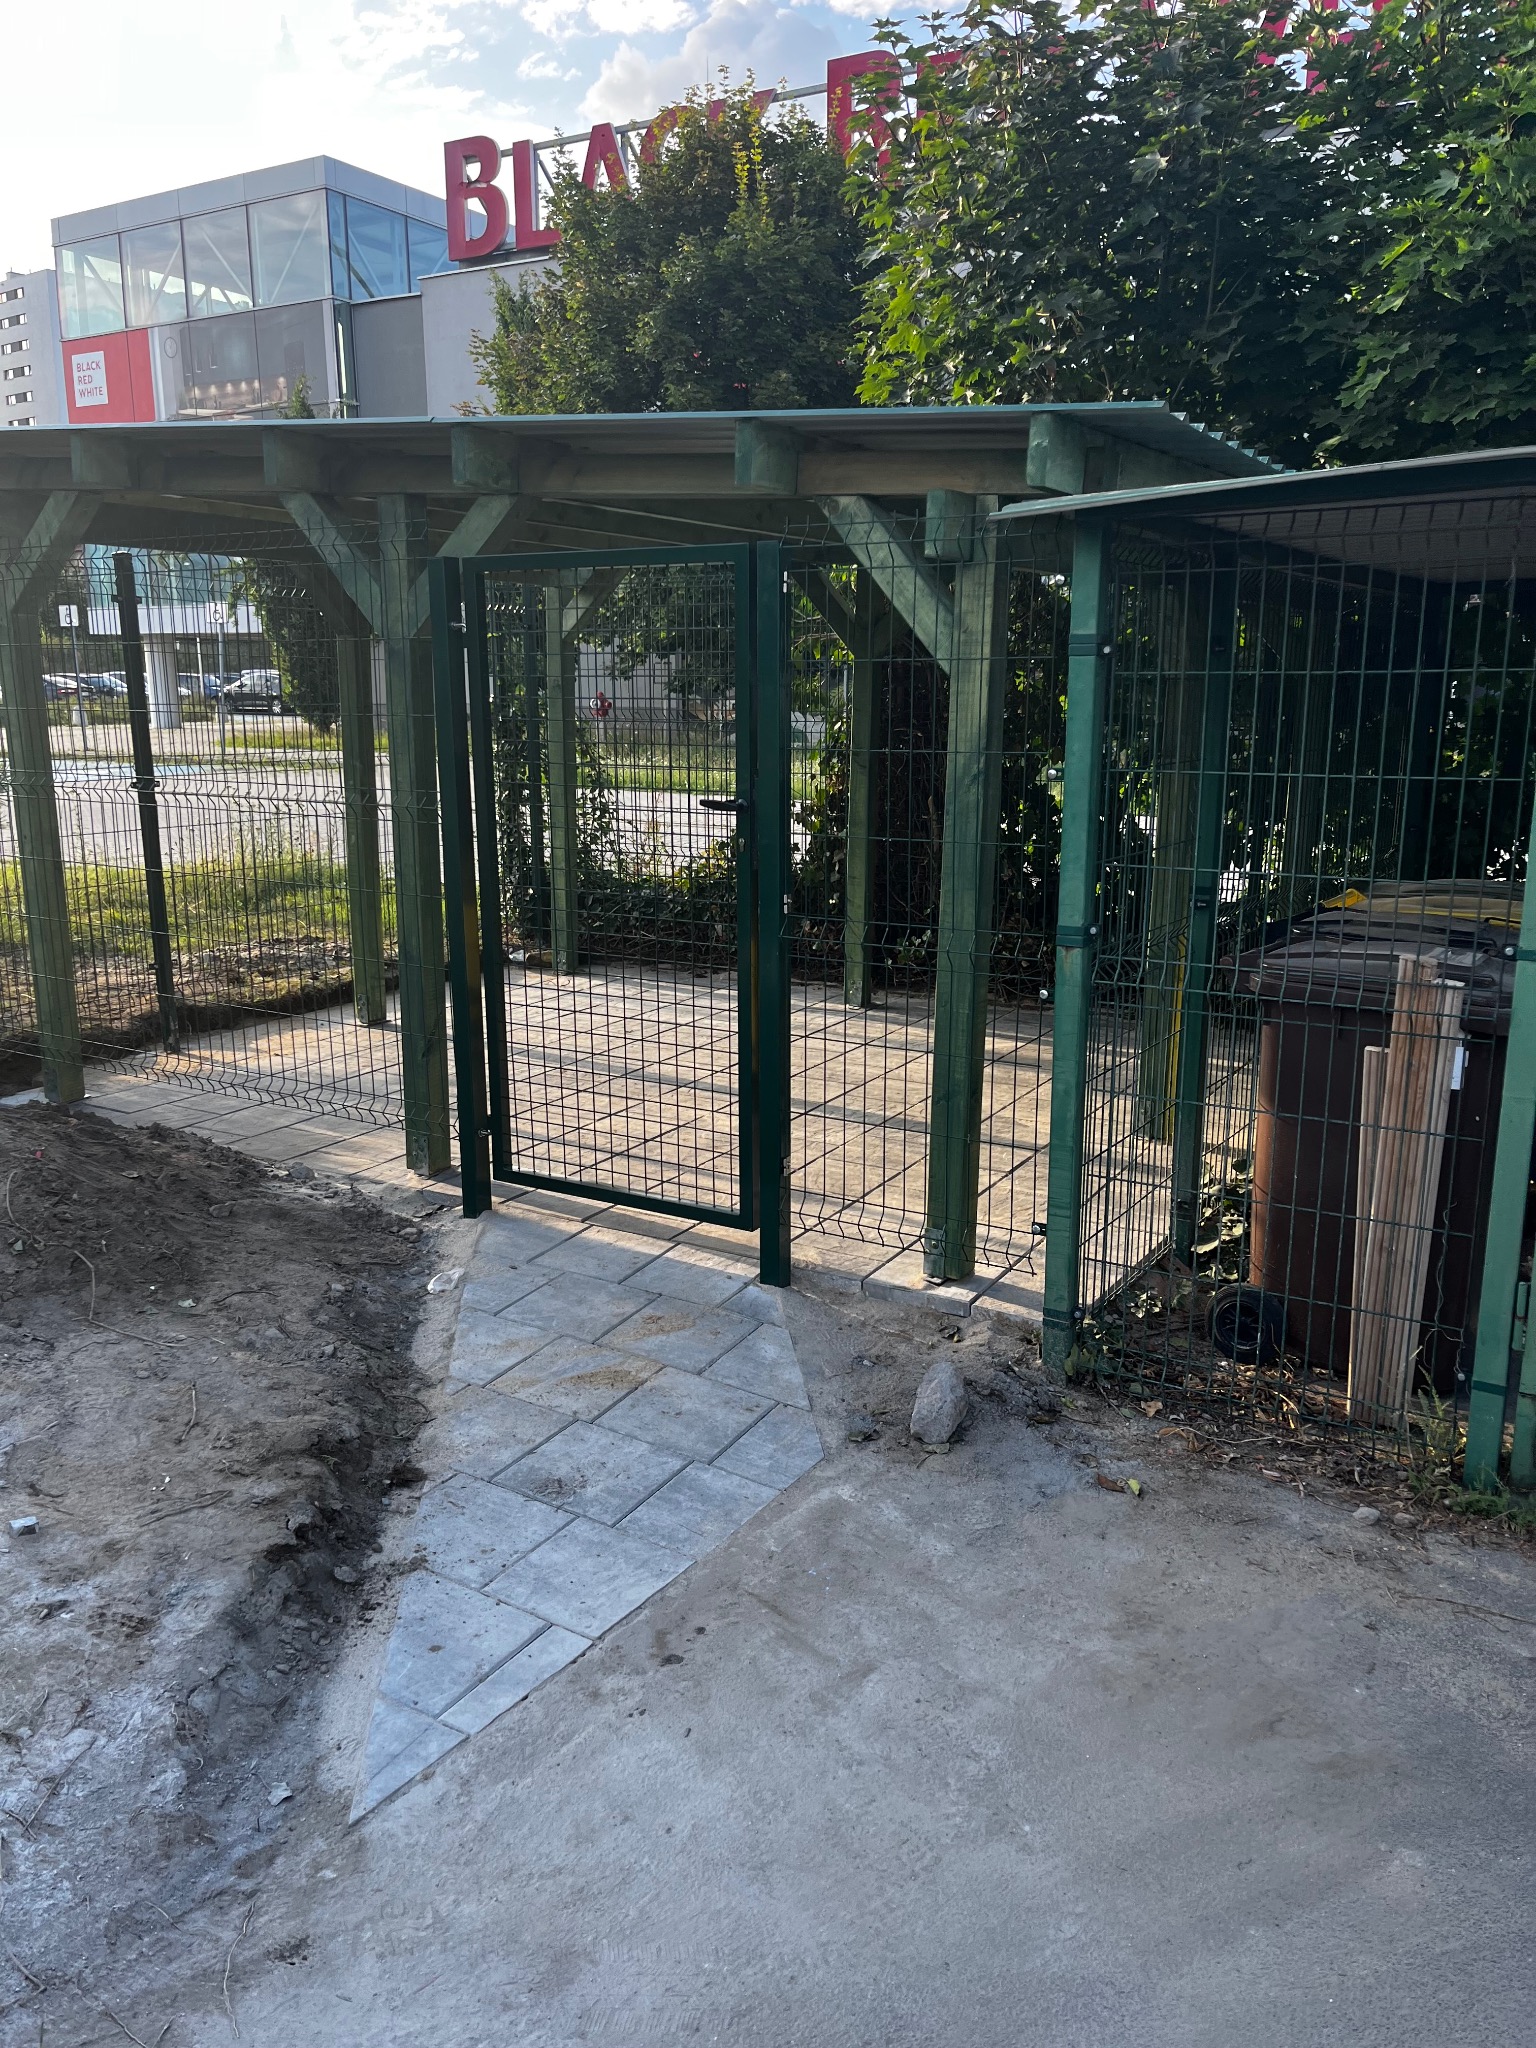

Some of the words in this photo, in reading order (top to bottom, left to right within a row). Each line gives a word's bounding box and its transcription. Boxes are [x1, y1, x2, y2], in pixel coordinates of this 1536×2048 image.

[443, 88, 777, 262] BLA
[76, 361, 101, 373] BLACK
[77, 375, 93, 386] RED
[78, 386, 104, 398] WHITE
